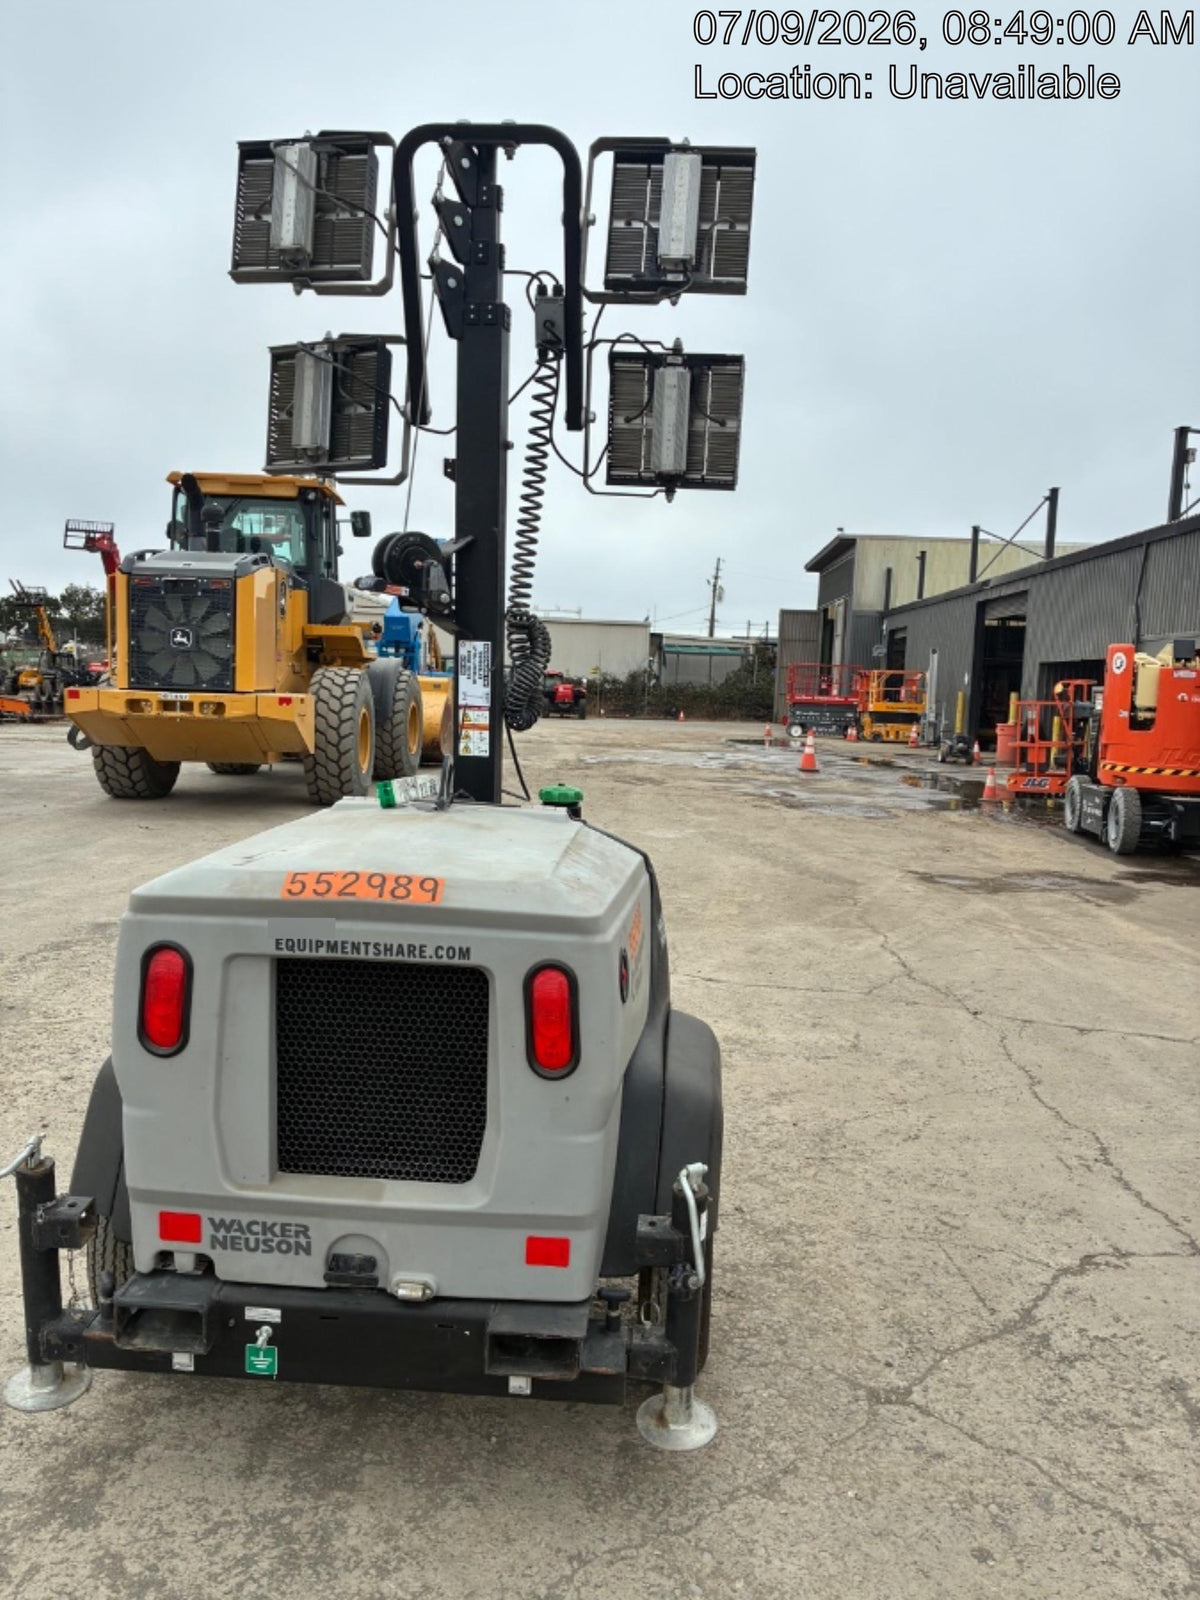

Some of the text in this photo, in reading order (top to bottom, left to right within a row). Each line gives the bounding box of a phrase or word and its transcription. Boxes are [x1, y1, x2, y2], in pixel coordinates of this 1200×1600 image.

[1022, 777, 1050, 788] JLG
[286, 871, 440, 902] 552989
[275, 938, 471, 961] EQUIPMENTSHARE.COM
[207, 1217, 312, 1239] WACKER
[210, 1234, 312, 1256] NEUSON
